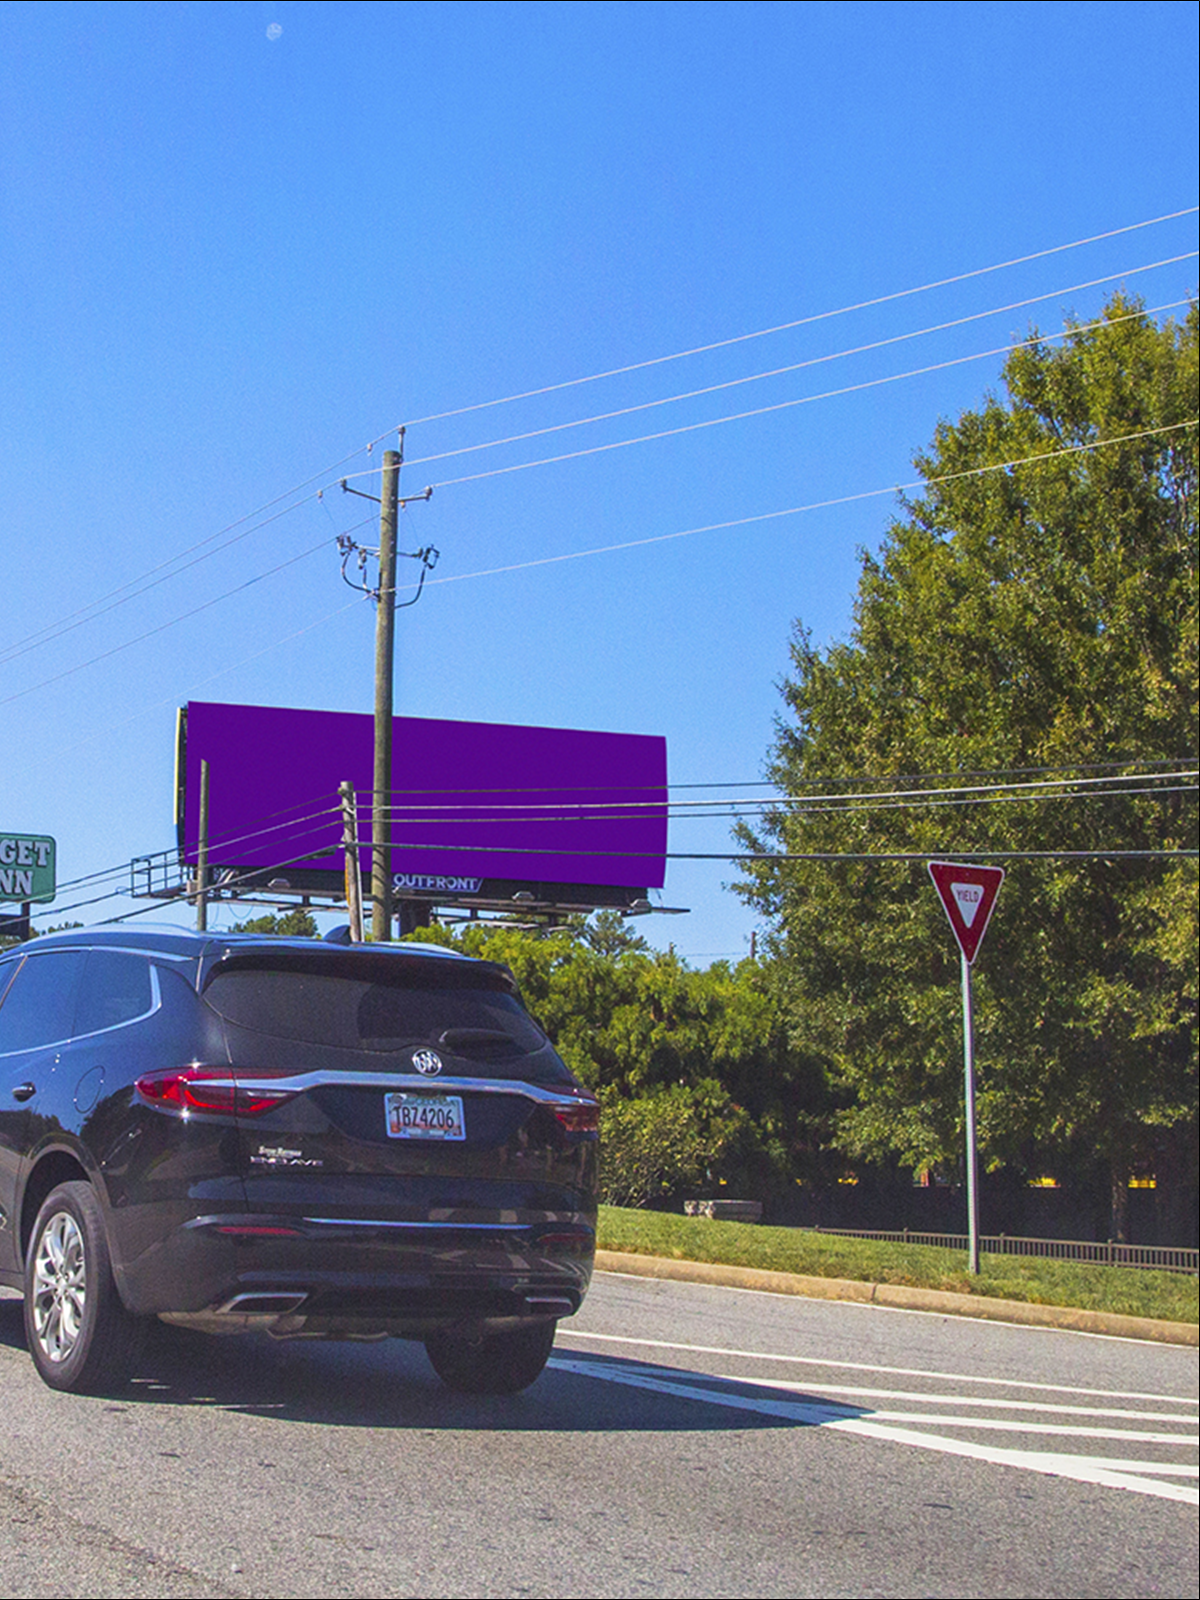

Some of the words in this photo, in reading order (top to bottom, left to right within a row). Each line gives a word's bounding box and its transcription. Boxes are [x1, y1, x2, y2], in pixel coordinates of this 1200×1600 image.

[393, 873, 478, 890] OUTFRONT
[956, 889, 980, 902] YIELD
[392, 1105, 455, 1129] TBZ4206
